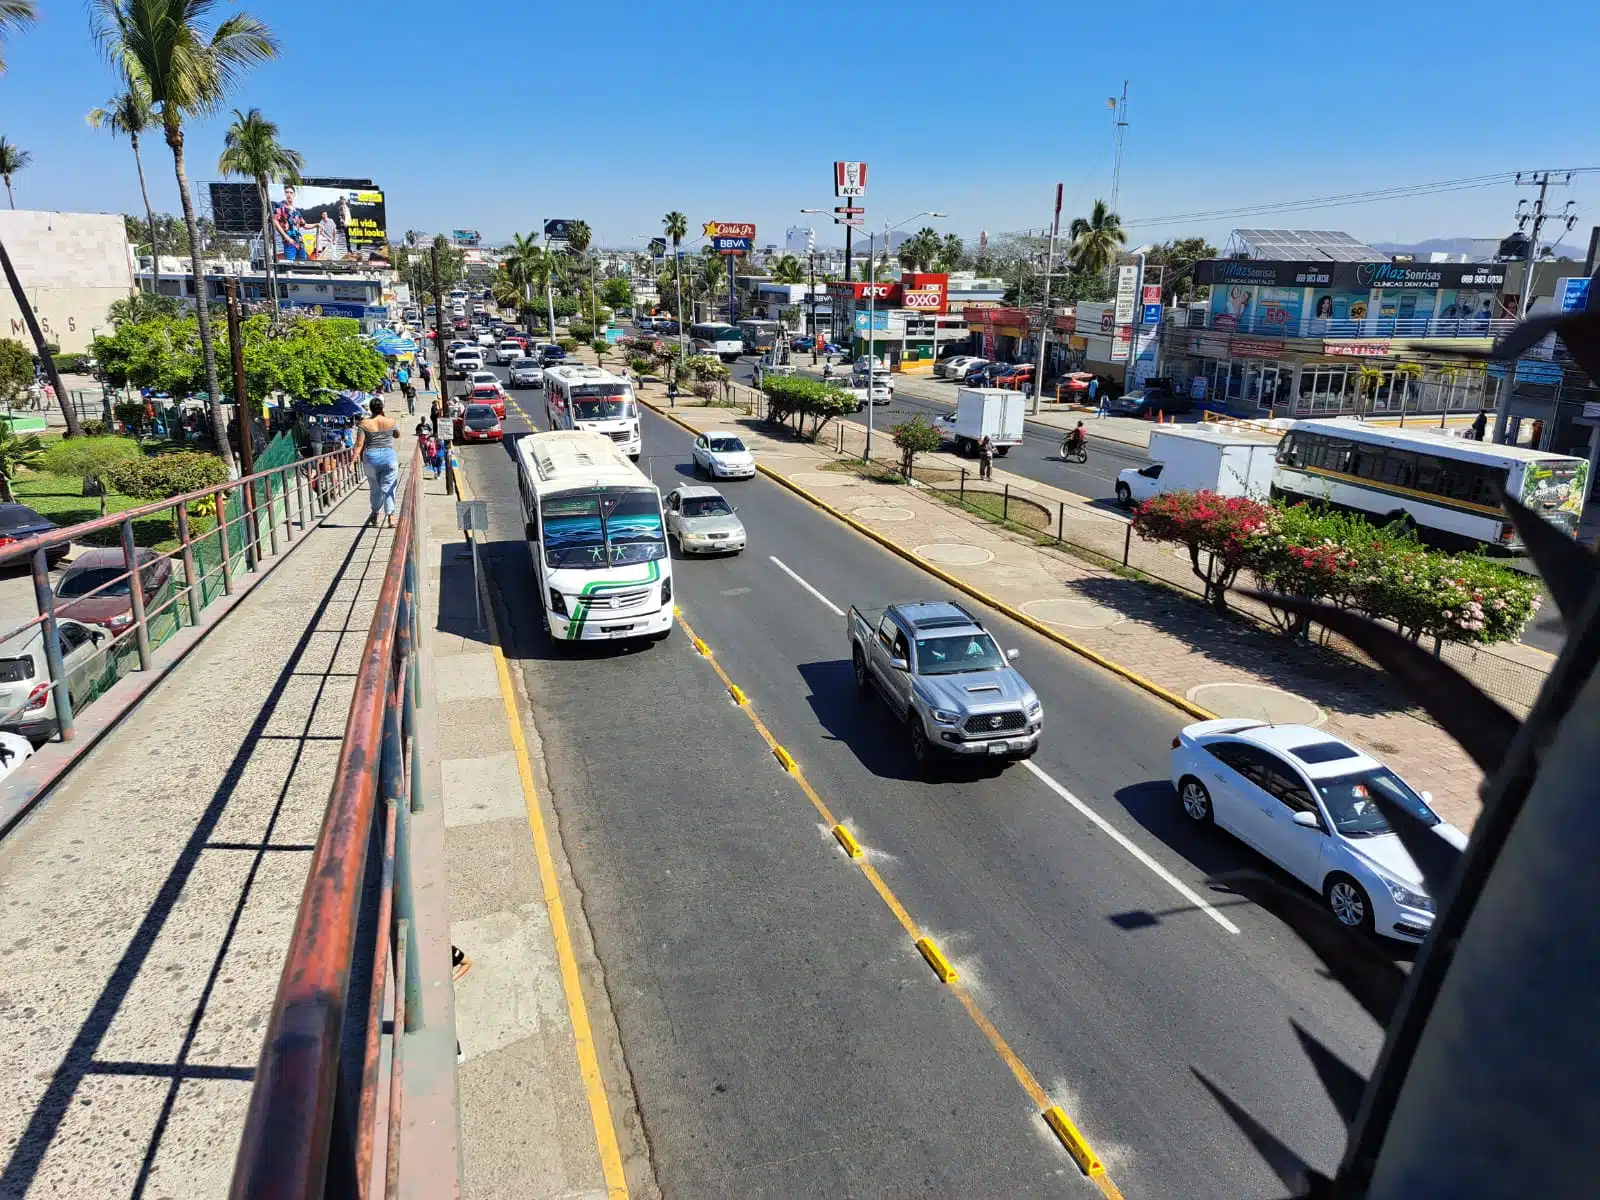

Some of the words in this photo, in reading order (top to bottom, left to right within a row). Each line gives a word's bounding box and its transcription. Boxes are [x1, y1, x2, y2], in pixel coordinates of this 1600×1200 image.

[843, 187, 861, 195] KFC
[360, 218, 377, 228] vida
[348, 228, 363, 237] Mis
[364, 228, 385, 237] looks
[720, 239, 745, 248] BBVA
[1376, 263, 1405, 279] Maz
[1405, 268, 1442, 280] Sonrisas
[862, 286, 888, 297] KFC
[906, 294, 940, 307] OXXO
